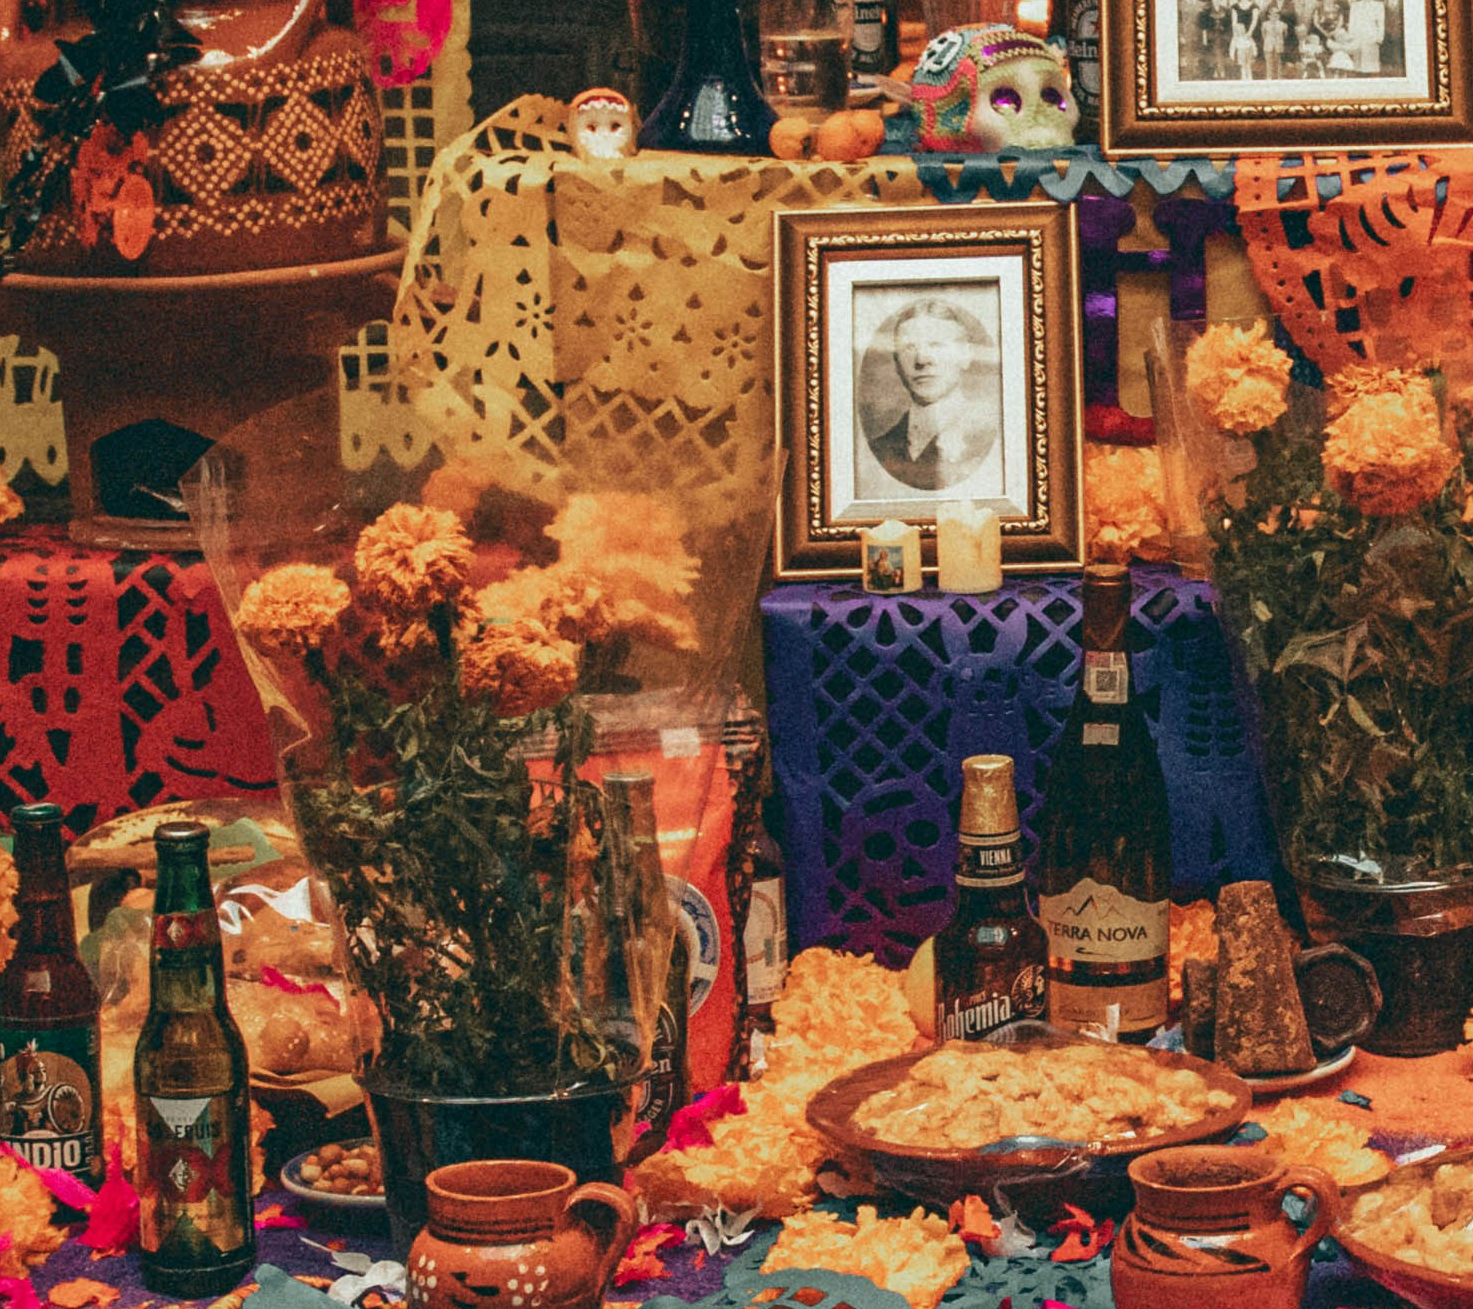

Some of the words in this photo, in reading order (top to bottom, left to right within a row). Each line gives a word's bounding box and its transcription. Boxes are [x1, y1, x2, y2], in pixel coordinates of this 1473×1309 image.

[979, 847, 1012, 867] VIENNA
[1047, 920, 1092, 941] TERRA
[1097, 925, 1148, 942] NOVA
[8, 1139, 82, 1168] NDIO
